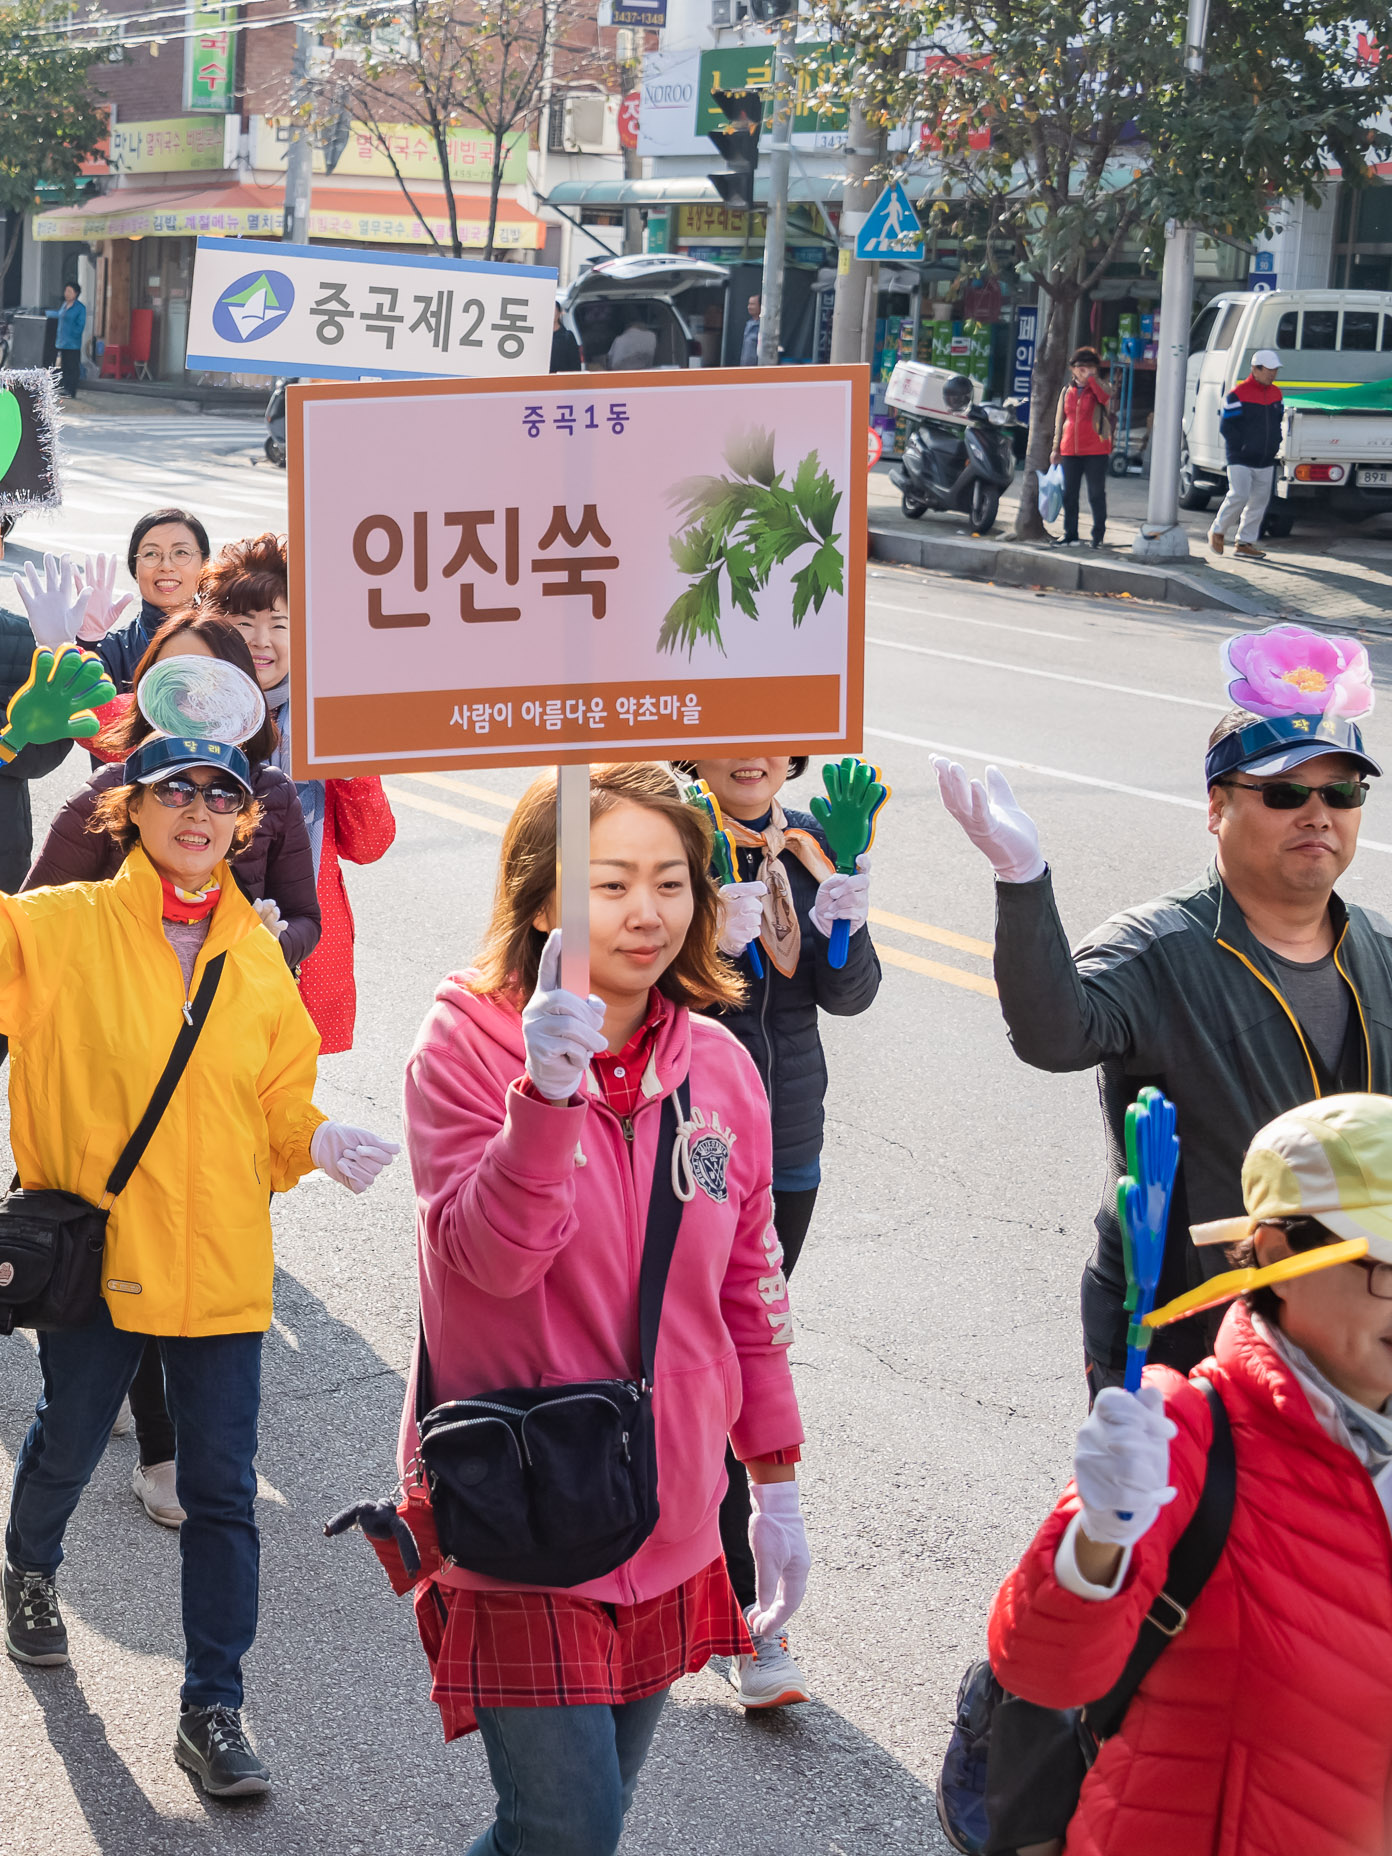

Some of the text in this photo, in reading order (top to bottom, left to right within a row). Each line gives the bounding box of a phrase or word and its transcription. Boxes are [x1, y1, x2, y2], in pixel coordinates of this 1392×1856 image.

[644, 82, 693, 105] NOROO
[308, 281, 535, 360] 중곡제2동
[521, 403, 630, 438] 중곡1동
[351, 503, 620, 630] 인진쑥
[449, 693, 703, 734] 사람이 아름다운 약초마을
